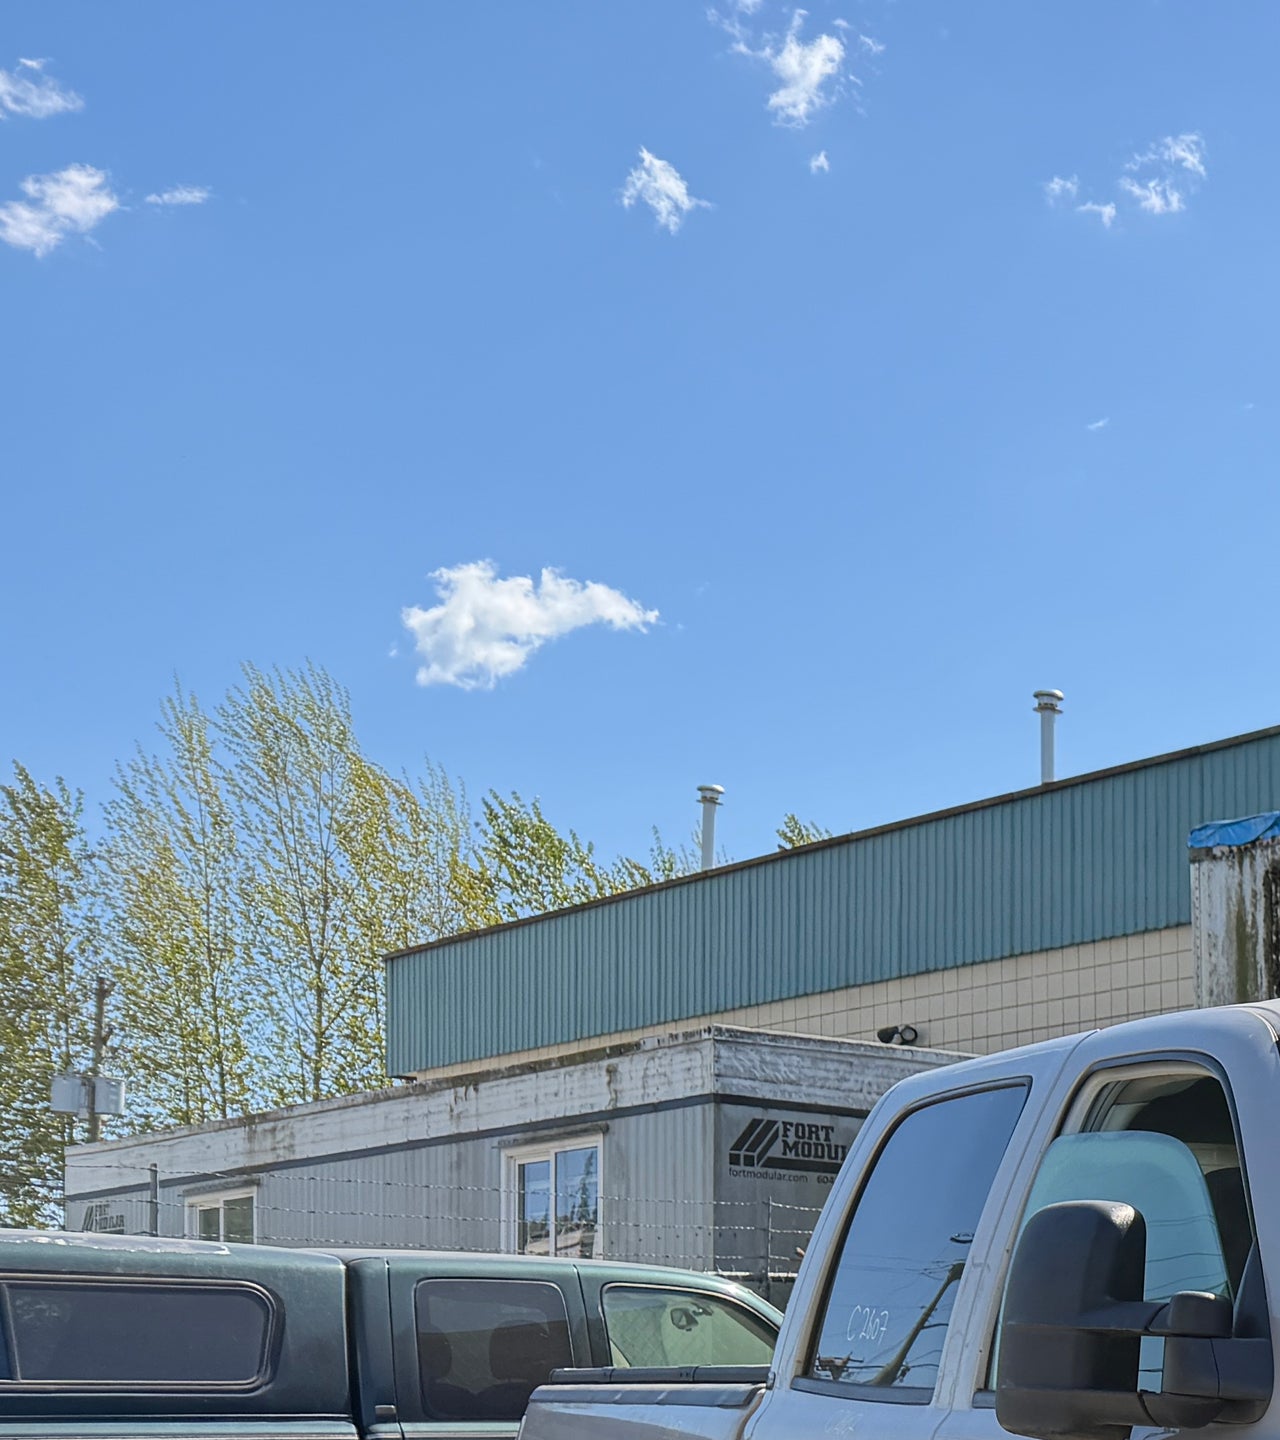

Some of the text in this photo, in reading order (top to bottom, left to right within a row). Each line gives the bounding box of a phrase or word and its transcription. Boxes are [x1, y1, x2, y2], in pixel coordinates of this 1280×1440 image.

[781, 1120, 835, 1143] FORT
[729, 1167, 809, 1184] fortmodular.com
[846, 1304, 889, 1344] C2607
